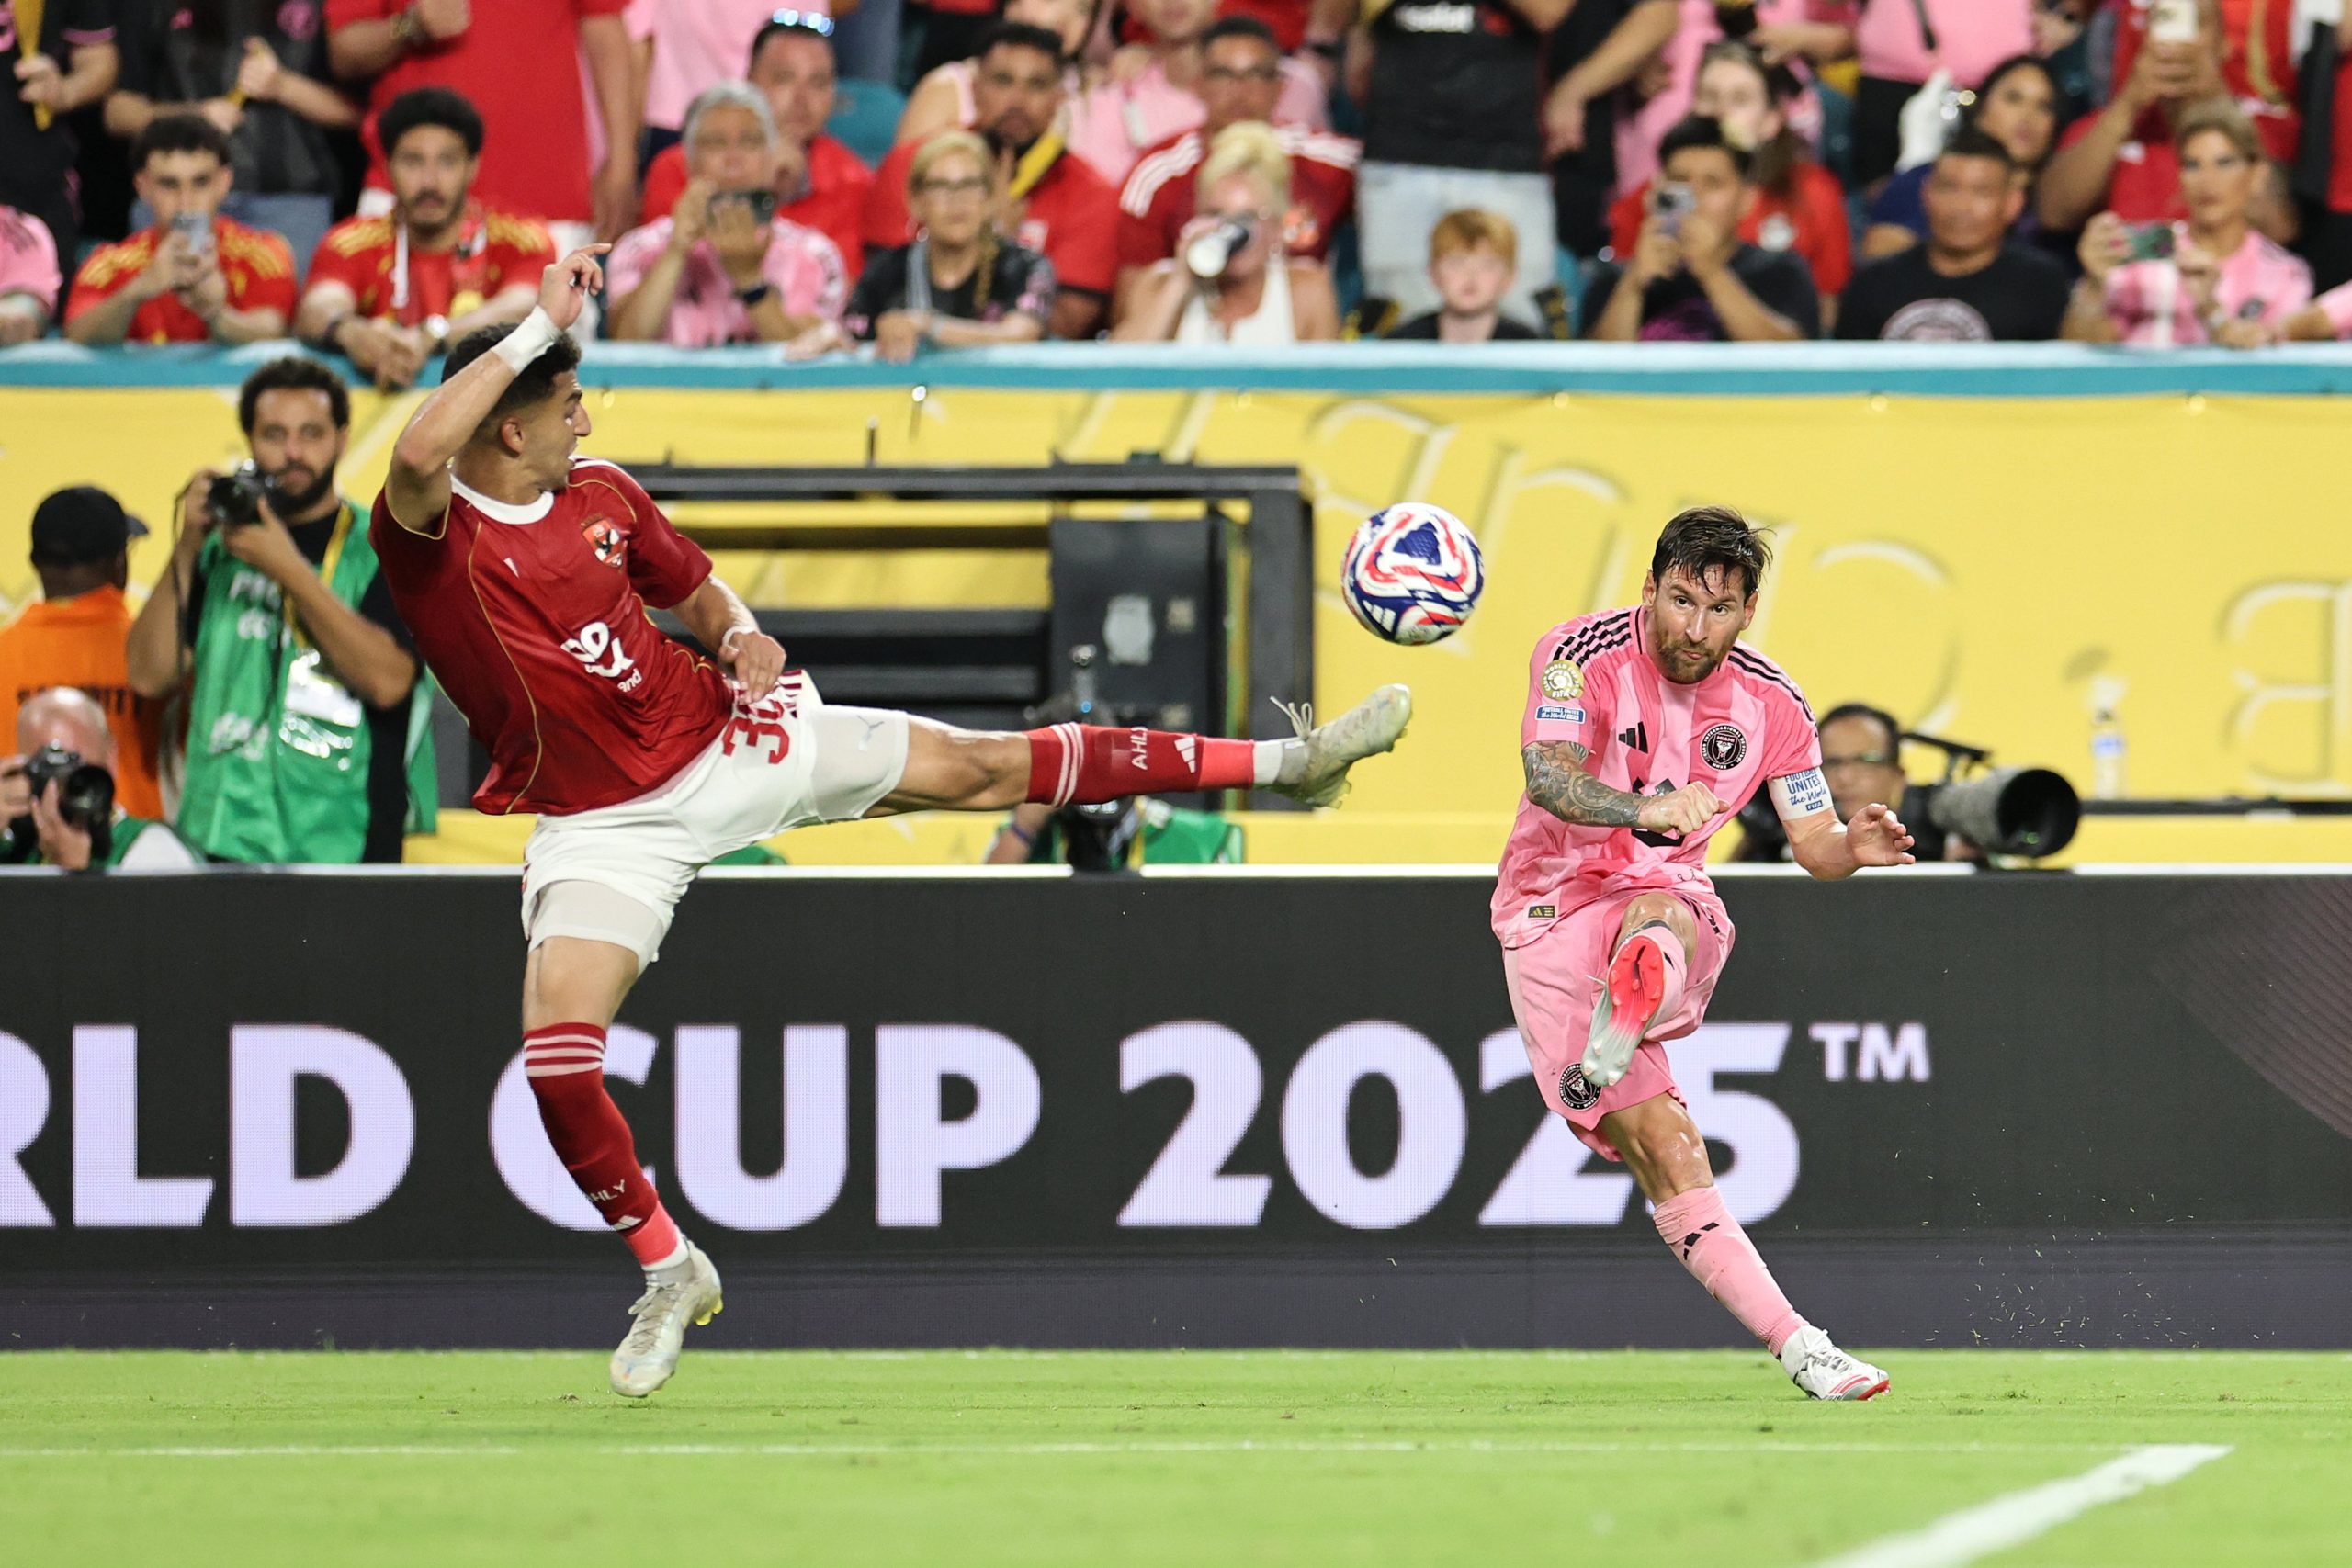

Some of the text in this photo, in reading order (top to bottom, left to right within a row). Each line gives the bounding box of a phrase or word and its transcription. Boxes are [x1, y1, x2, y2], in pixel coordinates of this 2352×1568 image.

[1787, 774, 1821, 795] UNITES
[489, 1022, 1042, 1232] CUP
[587, 1179, 626, 1202] HLY
